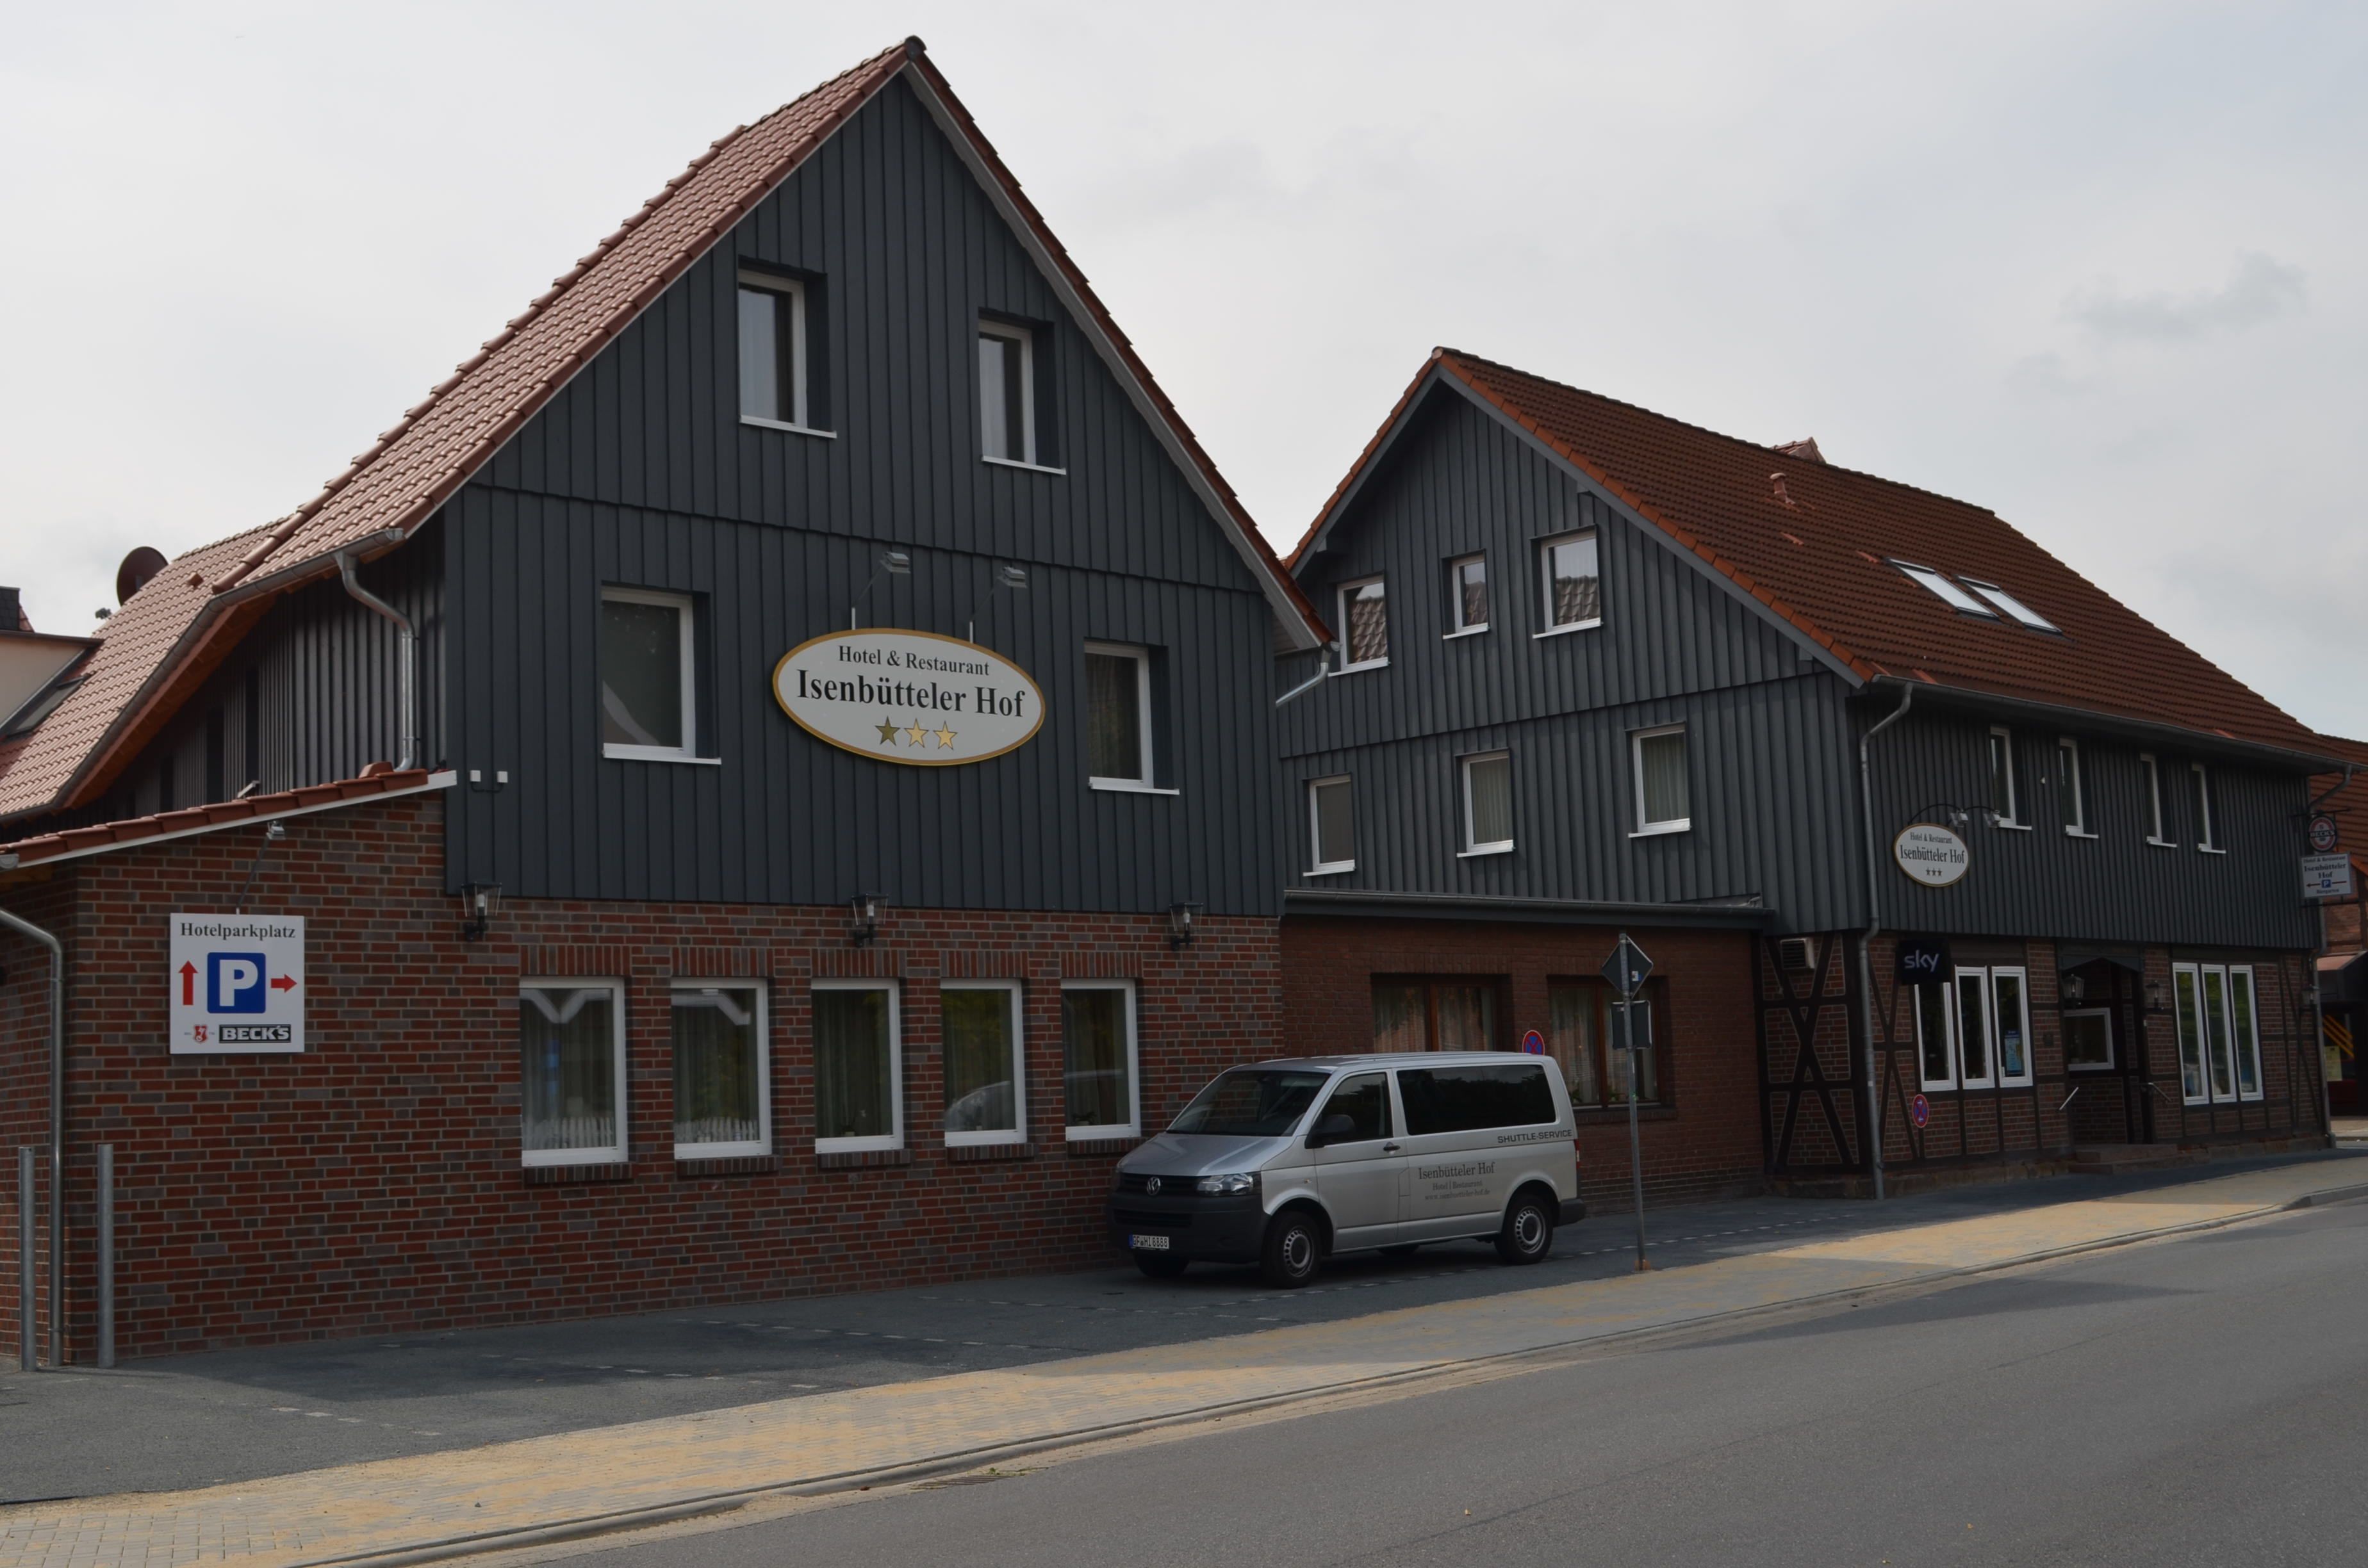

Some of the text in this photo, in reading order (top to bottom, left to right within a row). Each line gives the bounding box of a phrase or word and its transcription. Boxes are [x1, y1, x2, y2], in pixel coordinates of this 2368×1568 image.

[838, 645, 990, 676] Hotel & Restaurant
[796, 669, 1026, 717] Isenbütteler Hof
[1910, 831, 1953, 844] Hotel & Restaurant
[1900, 844, 1965, 864] Isenbütteler Hof
[2304, 863, 2346, 872] Isenbütteler
[181, 922, 296, 941] Hotelparkplatz
[1904, 949, 1940, 972] sky
[219, 960, 258, 1007] P
[222, 1025, 290, 1040] BECK'S
[1497, 1129, 1573, 1144] SHUTTLE-SERVICE
[1418, 1161, 1496, 1180] Isenbütteler Hof
[1433, 1181, 1449, 1191] Hotel
[1452, 1180, 1483, 1189] Restaurant
